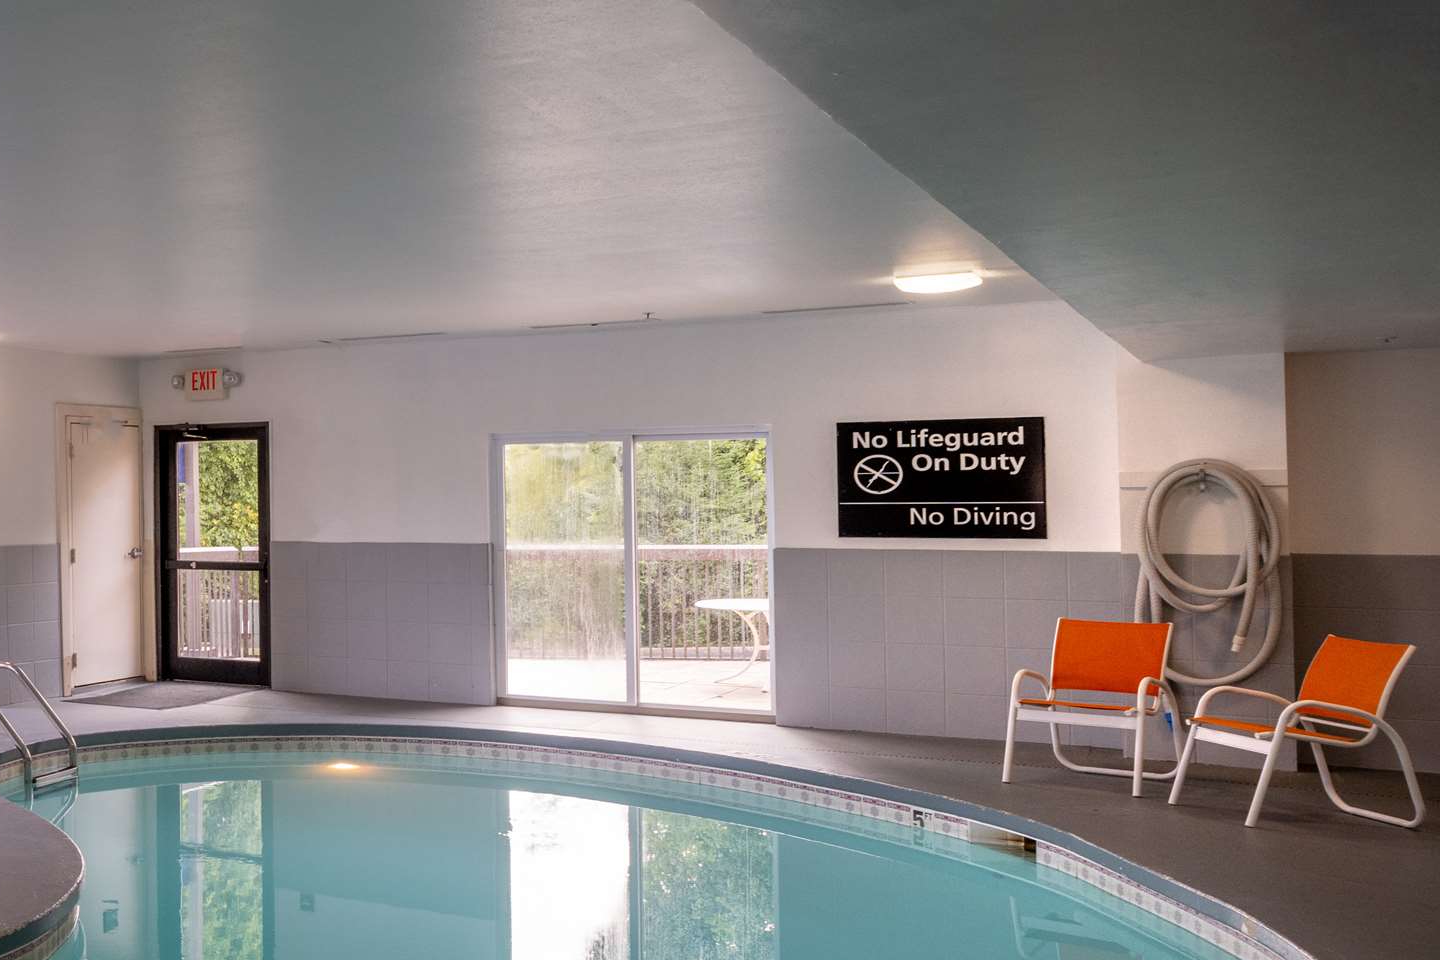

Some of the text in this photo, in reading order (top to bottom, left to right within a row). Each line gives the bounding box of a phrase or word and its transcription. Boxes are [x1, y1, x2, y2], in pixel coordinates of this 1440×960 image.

[192, 370, 217, 391] EXIT
[852, 426, 1025, 452] No Lifeguard
[911, 453, 1026, 475] On Duty
[910, 507, 1036, 530] No Diving
[913, 810, 925, 827] 5
